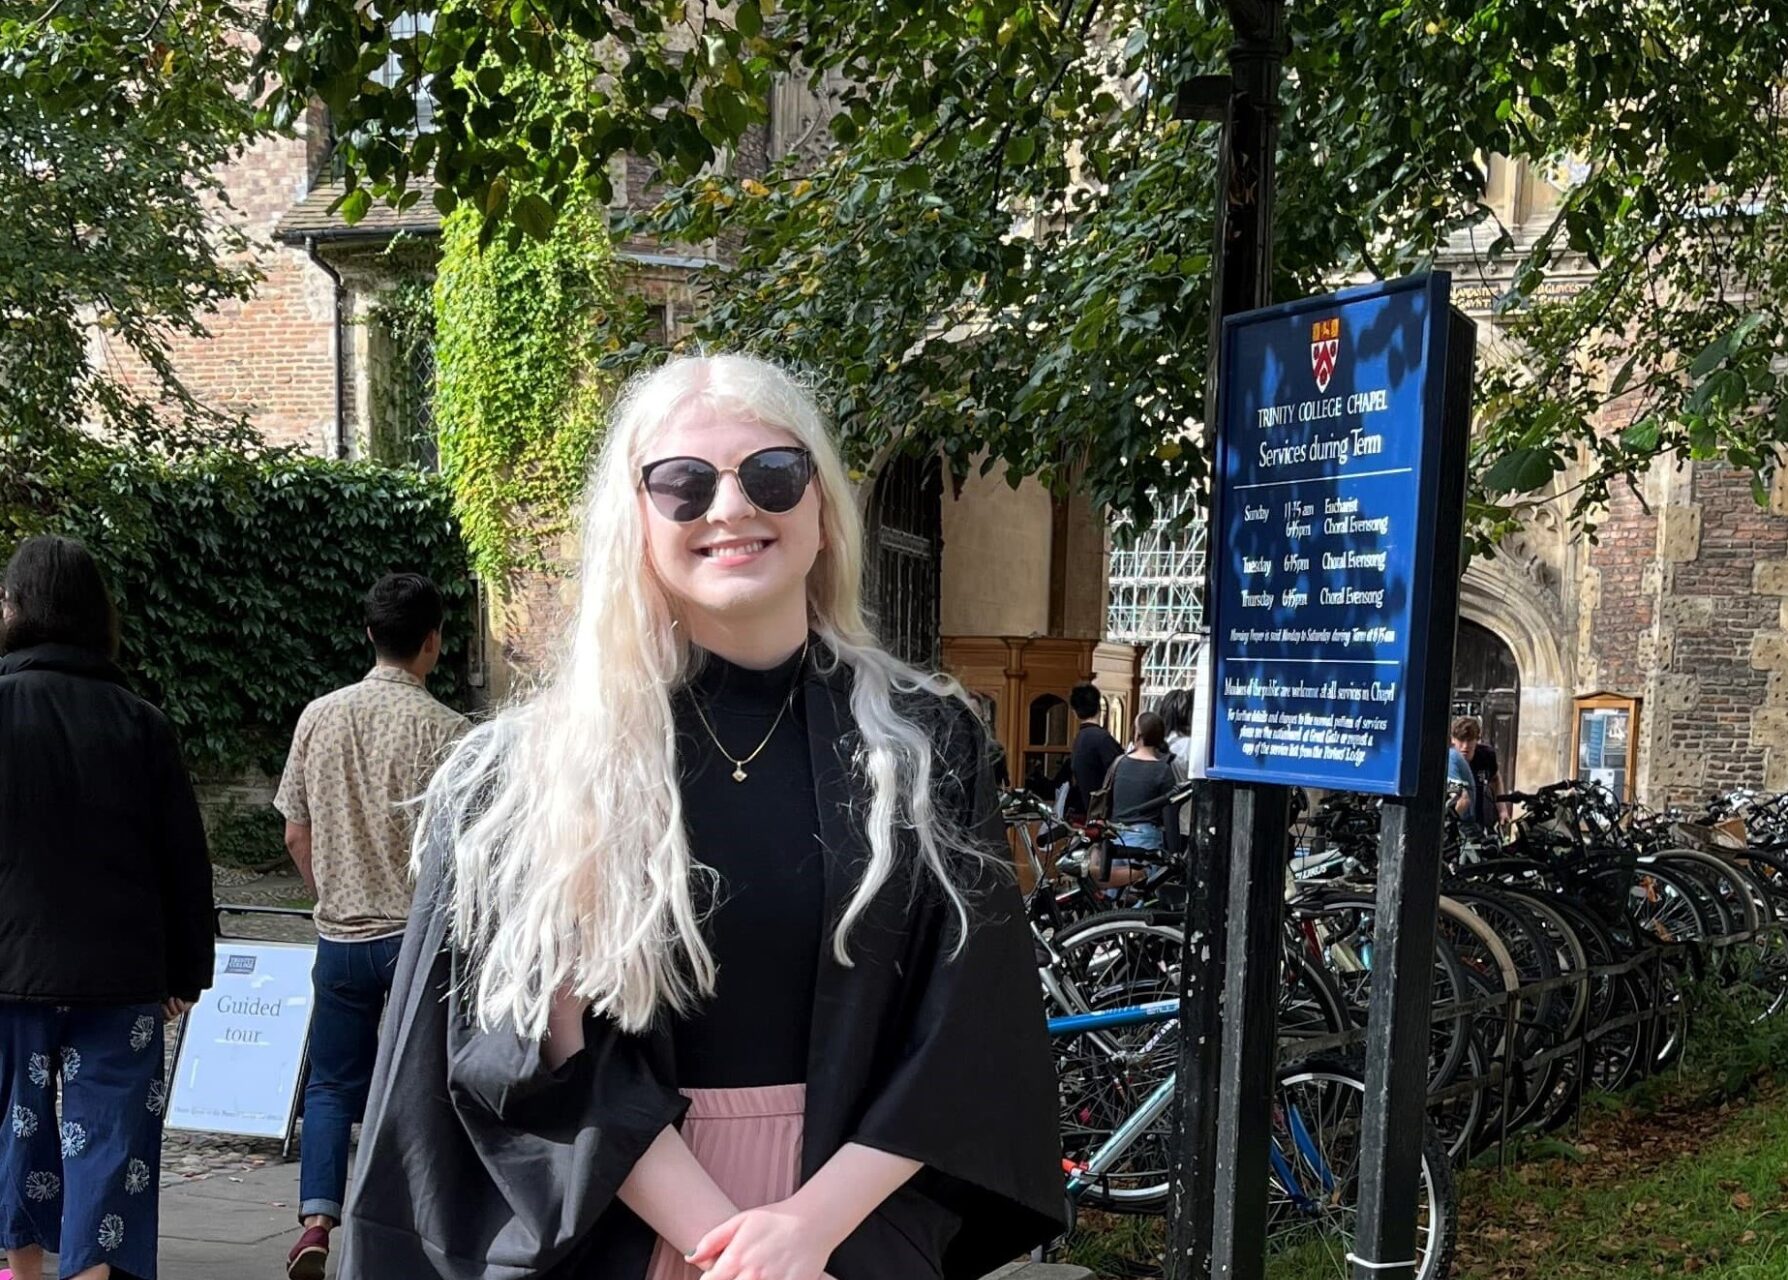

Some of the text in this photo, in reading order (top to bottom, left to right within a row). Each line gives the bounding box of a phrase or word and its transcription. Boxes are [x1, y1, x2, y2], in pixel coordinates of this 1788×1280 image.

[1258, 389, 1388, 428] TRINITY COLLEGE CHAPEL
[1258, 428, 1382, 467] Services during Term
[1244, 504, 1270, 523] Sunday
[1324, 496, 1359, 514] Eucharist
[1324, 516, 1348, 535] Choral
[1349, 515, 1389, 535] Evensong
[1242, 555, 1272, 577] Tuesday
[1322, 551, 1347, 570] Choral
[1348, 549, 1387, 571] Evensong
[1241, 589, 1275, 610] Thursday
[1320, 586, 1345, 605] Choral
[1346, 586, 1385, 608] Evensong
[1306, 628, 1331, 644] Saturday
[1331, 628, 1351, 648] during
[1224, 677, 1247, 696] Members
[1261, 679, 1279, 701] public
[1280, 686, 1291, 698] are
[1291, 679, 1319, 699] welcome
[1319, 683, 1328, 699] at
[1327, 680, 1337, 700] all
[1337, 681, 1362, 701] services
[1361, 682, 1370, 701] in
[1370, 681, 1396, 706] Chapel
[1354, 715, 1363, 731] of
[1361, 716, 1388, 731] services
[1309, 728, 1326, 744] Great
[1325, 728, 1341, 744] Gate
[1344, 747, 1367, 768] Lodge
[217, 994, 282, 1017] Guided
[225, 1027, 263, 1044] tour
